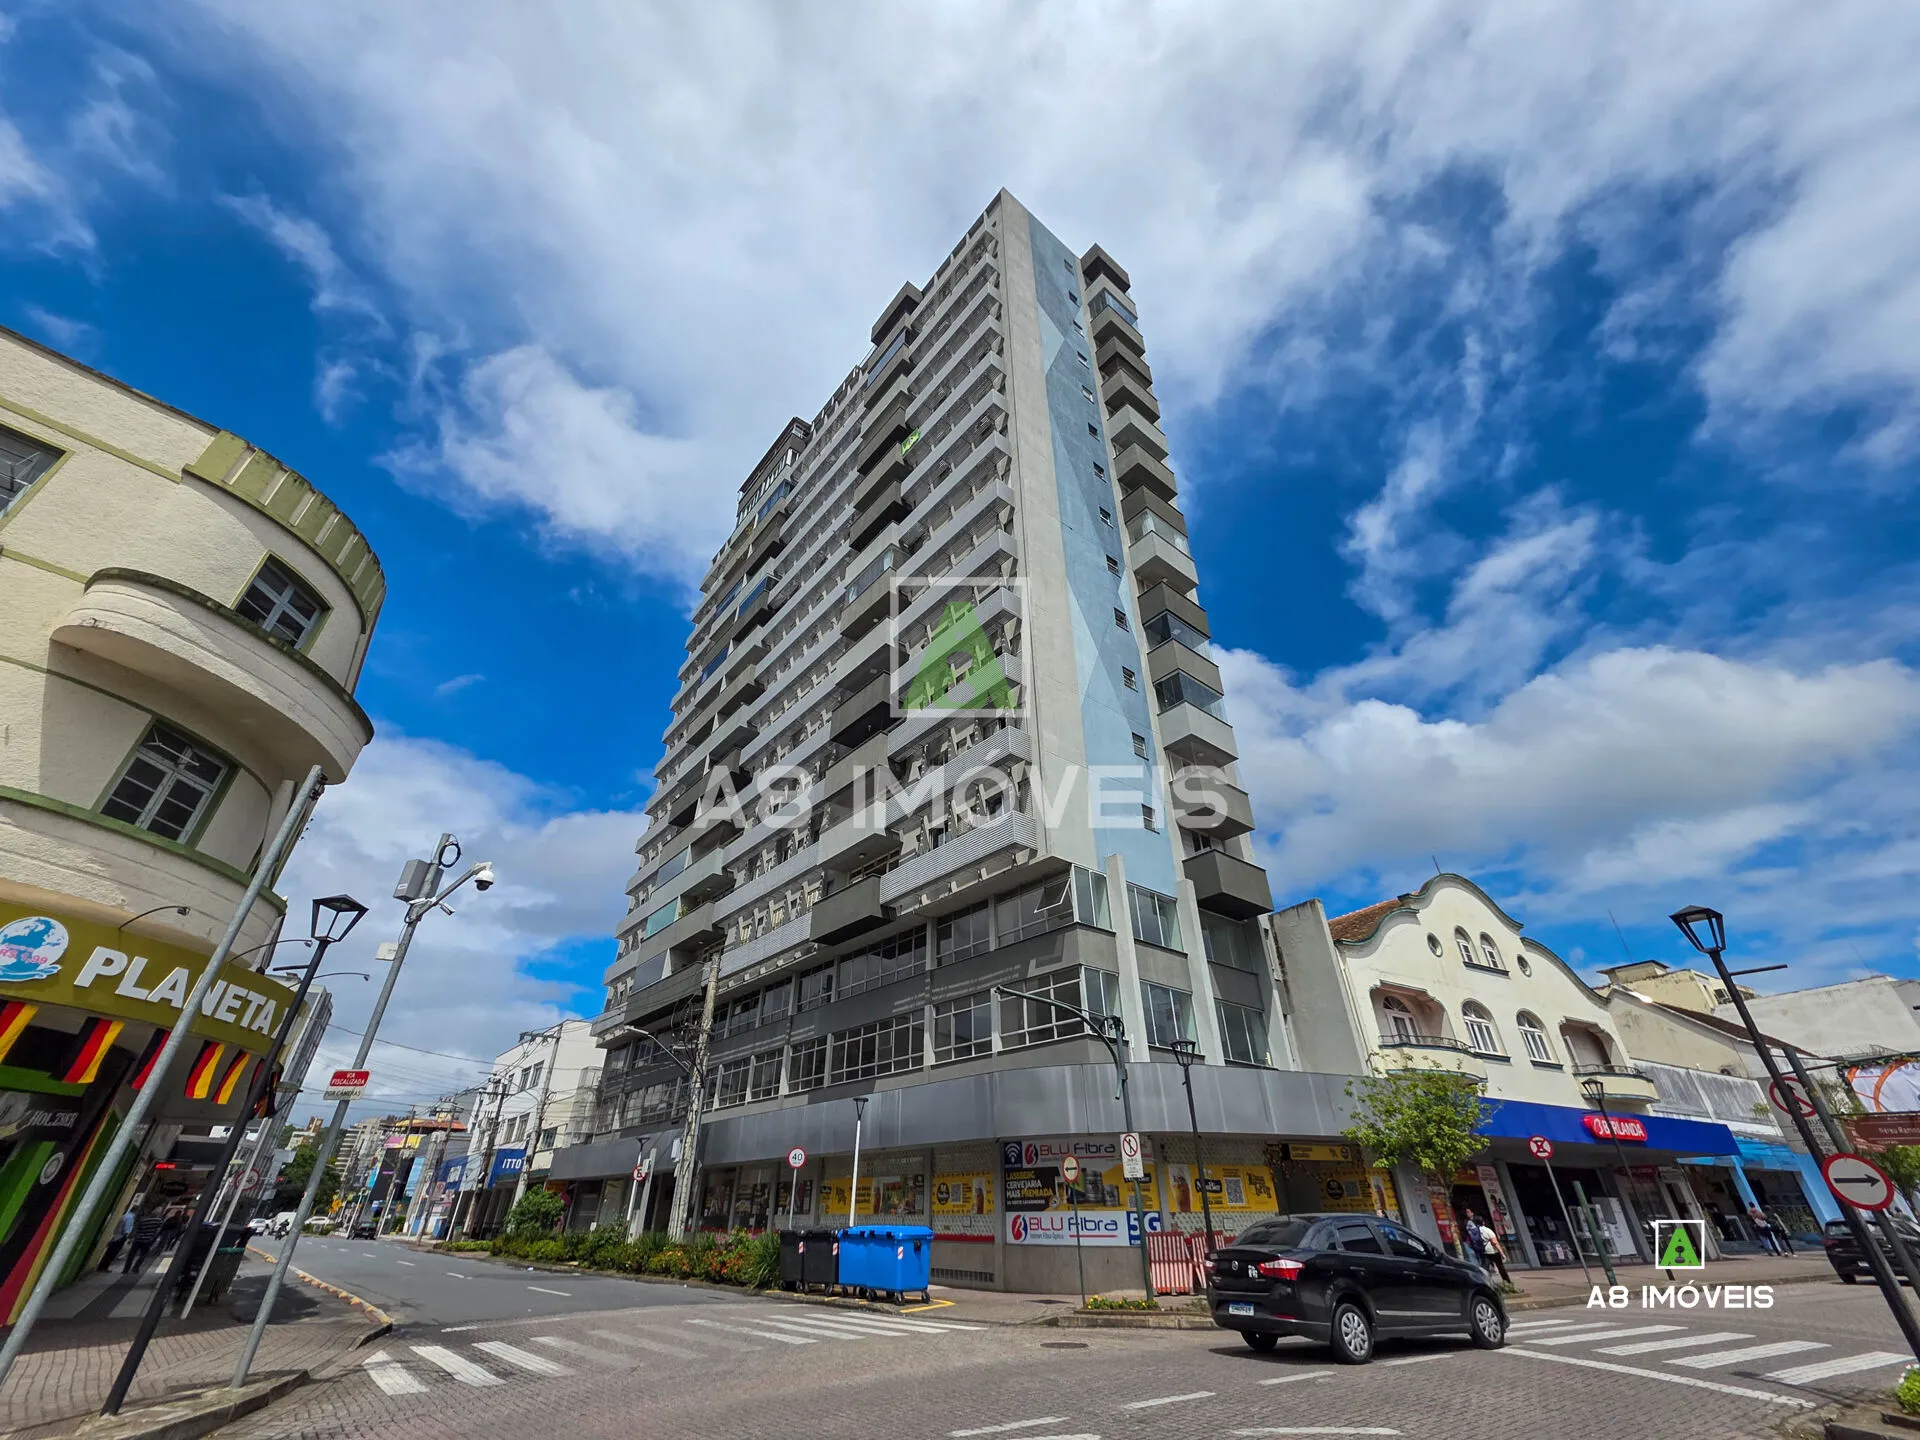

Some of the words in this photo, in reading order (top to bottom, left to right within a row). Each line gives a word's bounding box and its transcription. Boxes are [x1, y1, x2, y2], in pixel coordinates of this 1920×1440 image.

[1601, 1119, 1645, 1137] BRLANDA
[1040, 1142, 1070, 1156] BLU
[791, 1152, 803, 1161] 40
[1006, 1179, 1042, 1190] CERVEJARIA
[1006, 1189, 1021, 1199] MAIS
[1029, 1216, 1064, 1231] BLU
[1129, 1211, 1161, 1235] 5G
